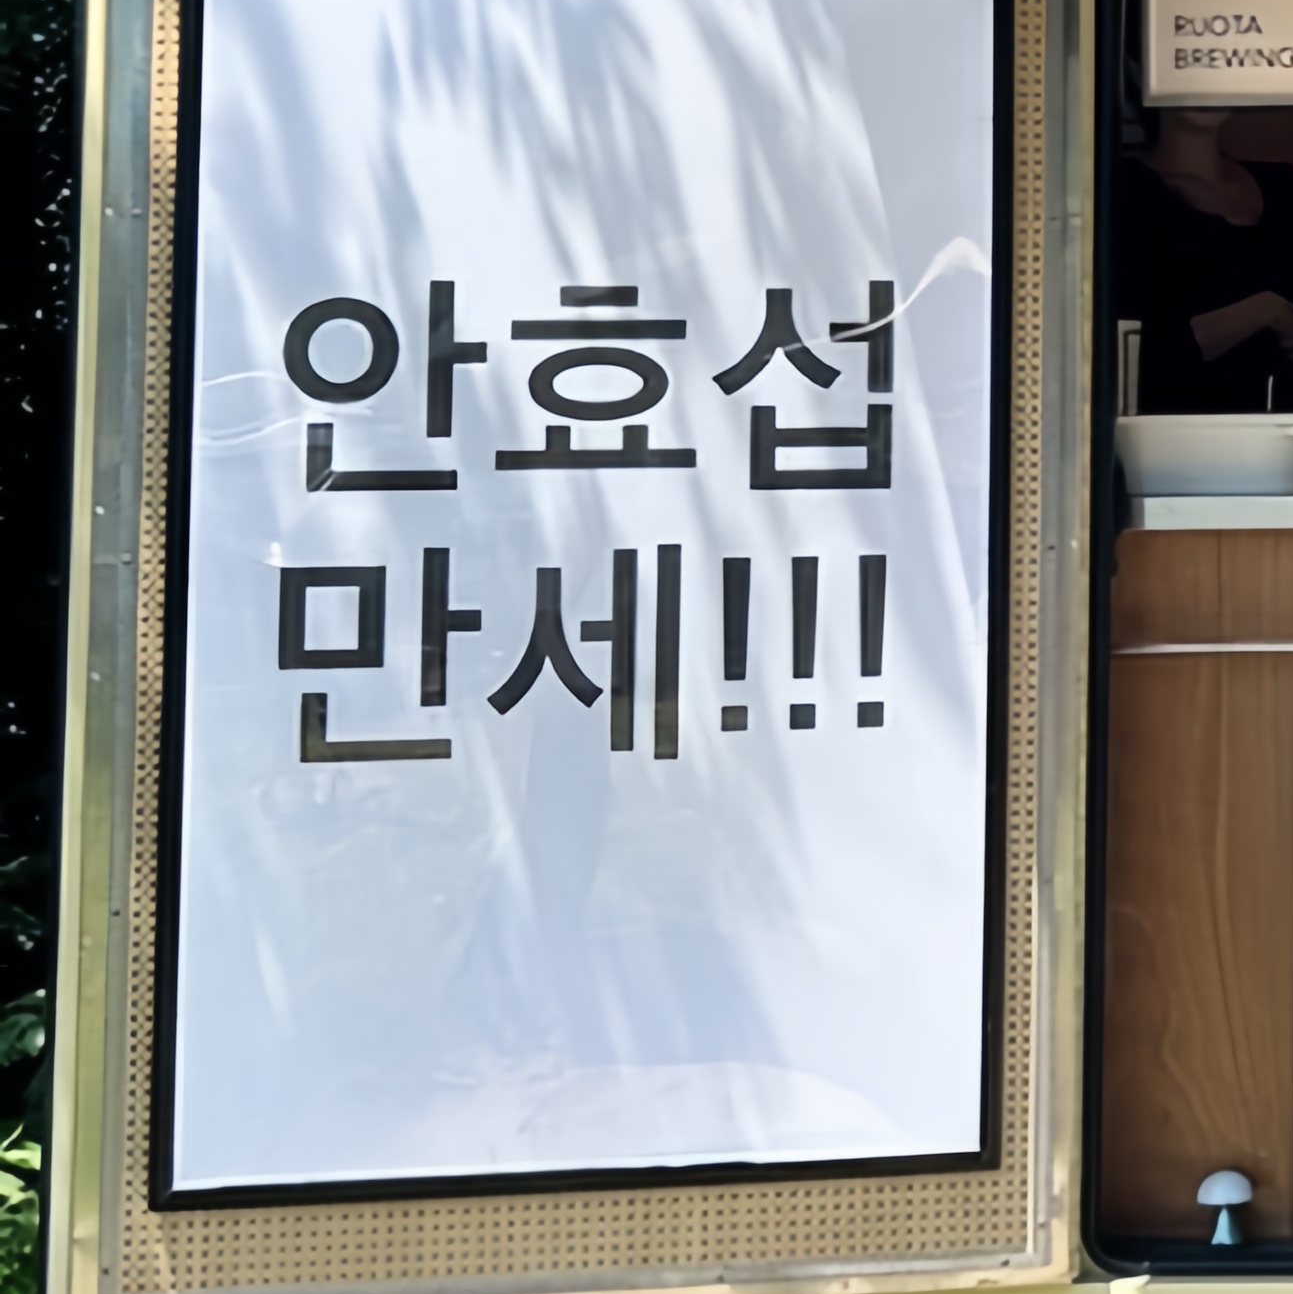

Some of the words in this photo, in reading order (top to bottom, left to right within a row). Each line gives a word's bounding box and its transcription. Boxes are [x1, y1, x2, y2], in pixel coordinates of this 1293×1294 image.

[1173, 14, 1264, 37] RUOTA
[282, 279, 896, 492] 안효섭
[277, 543, 888, 763] 만세!!!
